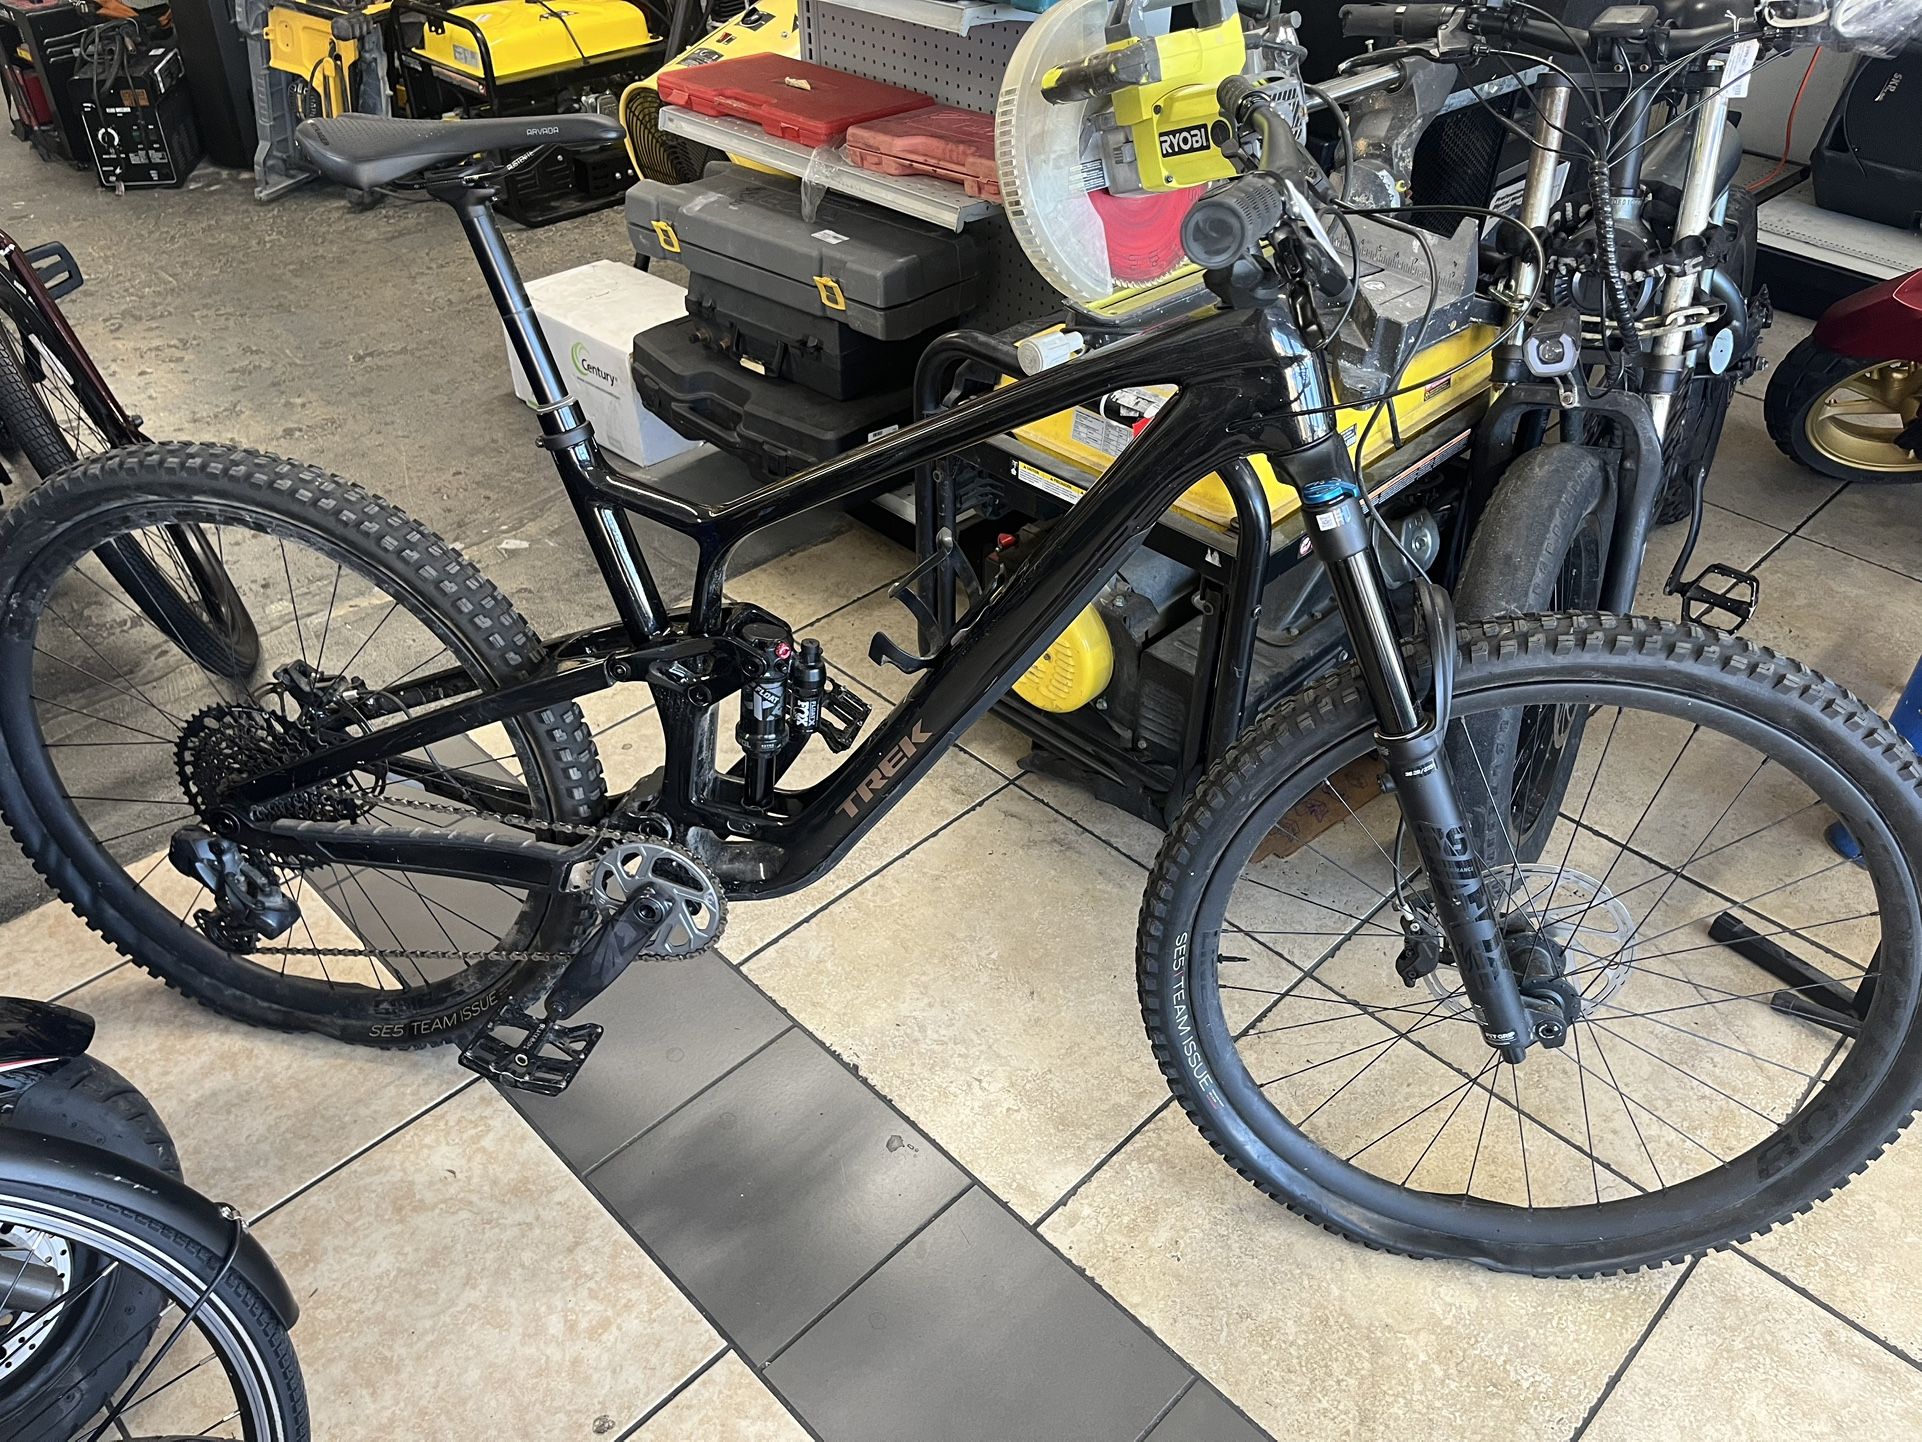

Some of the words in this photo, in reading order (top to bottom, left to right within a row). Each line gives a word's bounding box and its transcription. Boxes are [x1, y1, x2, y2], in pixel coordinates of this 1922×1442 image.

[526, 126, 560, 136] ARVADA
[1159, 128, 1208, 154] RYOBI
[581, 358, 615, 387] Century
[754, 686, 780, 704] FLOAT
[794, 700, 810, 728] FOX
[834, 718, 933, 818] TREK
[1172, 932, 1188, 971] SE5
[368, 1024, 405, 1038] SE5
[411, 1013, 458, 1036] TEAM
[460, 990, 498, 1022] ISSUE
[1172, 976, 1191, 1036] TEAM
[1182, 1035, 1214, 1092] ISSUE
